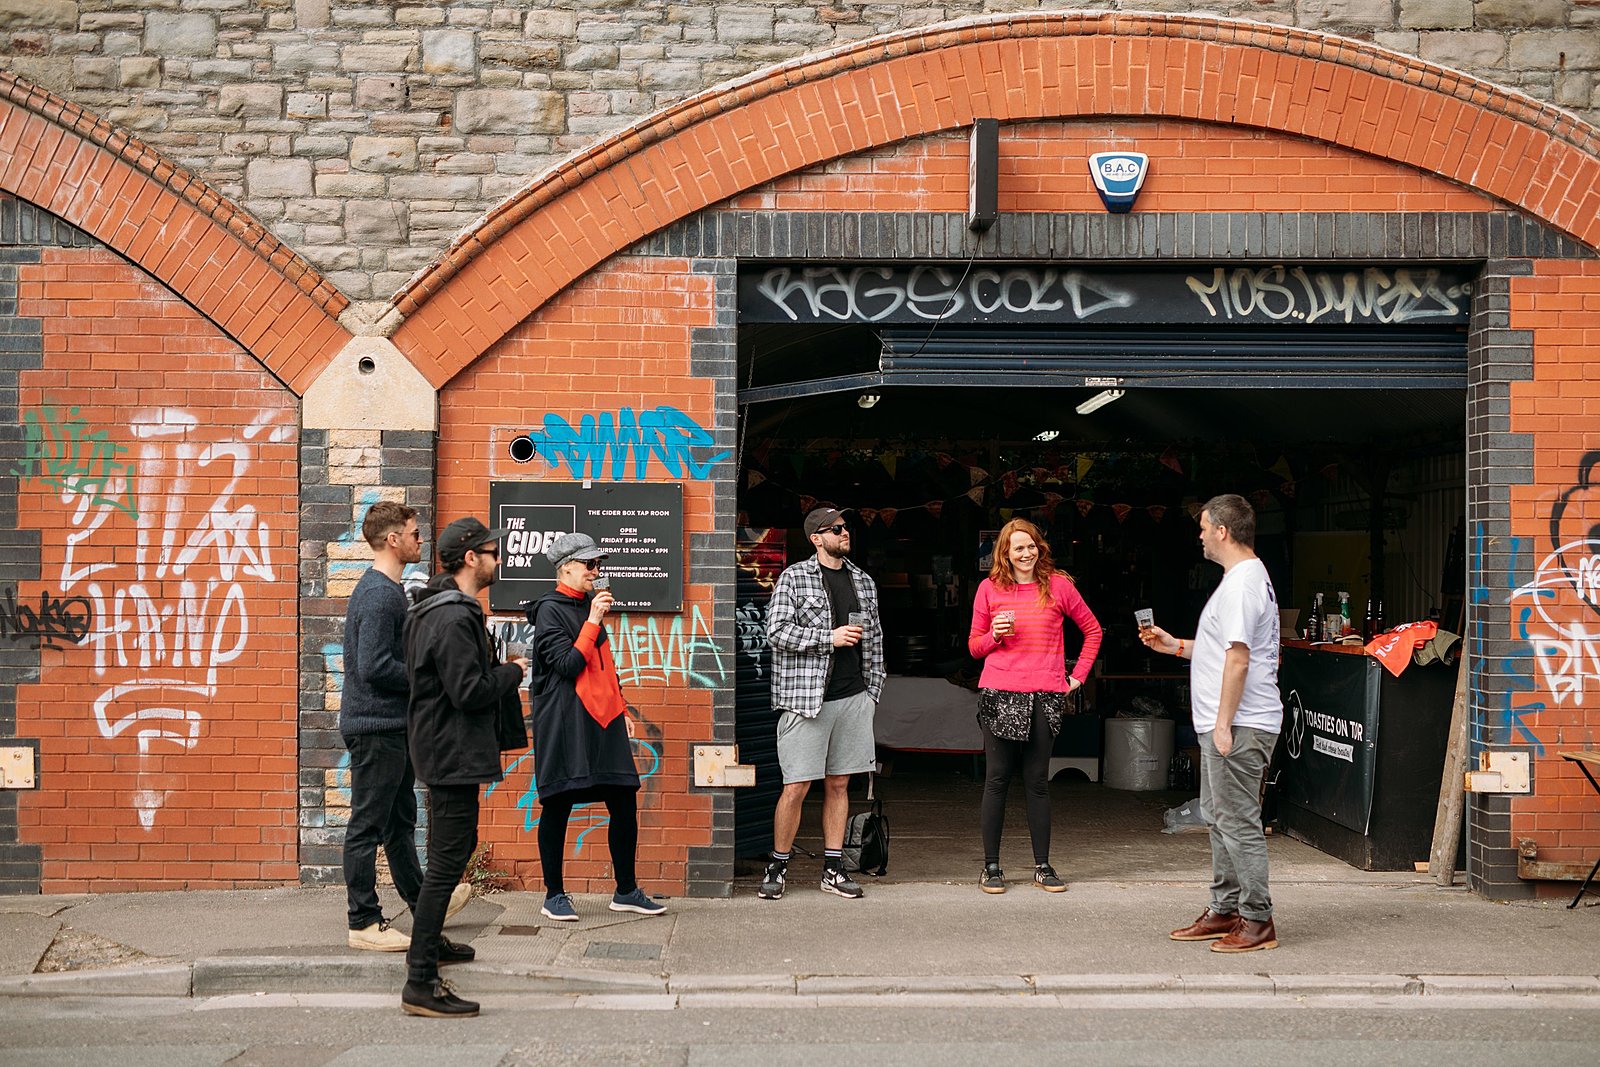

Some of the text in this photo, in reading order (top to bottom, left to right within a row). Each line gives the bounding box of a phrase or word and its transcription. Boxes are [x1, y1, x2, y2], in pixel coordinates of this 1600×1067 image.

[1104, 163, 1136, 173] B.A.C
[506, 517, 526, 530] THE
[1305, 709, 1335, 734] TOASTIES
[1335, 717, 1349, 738] ON
